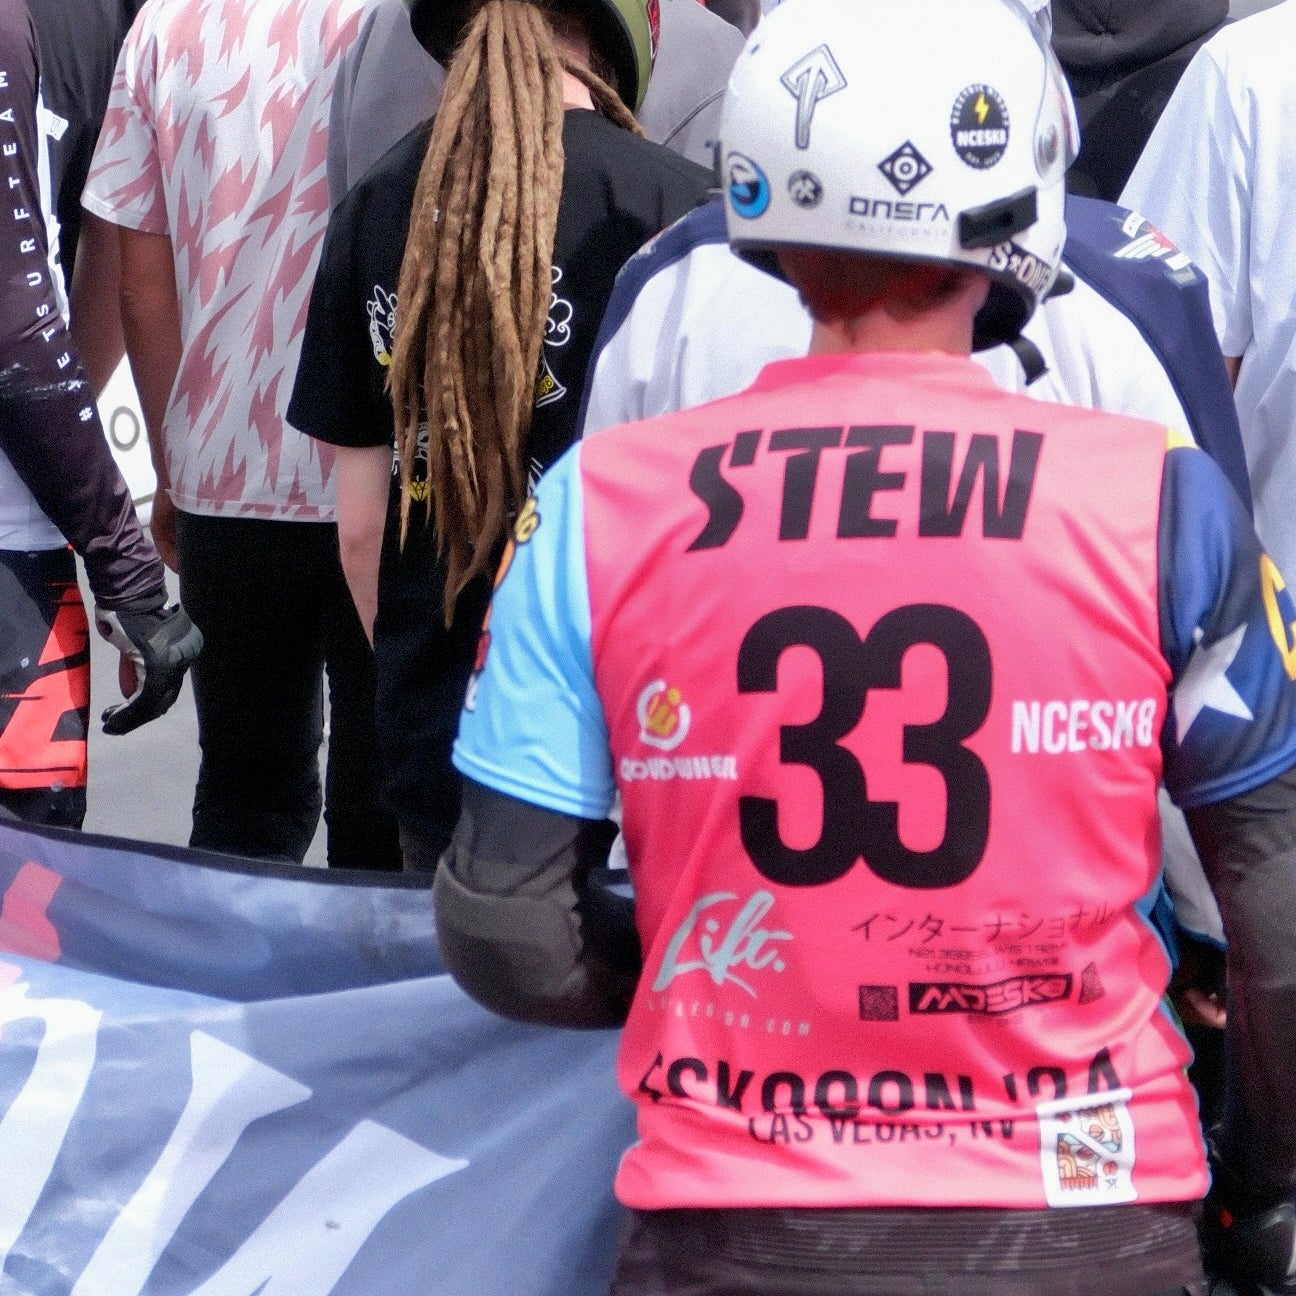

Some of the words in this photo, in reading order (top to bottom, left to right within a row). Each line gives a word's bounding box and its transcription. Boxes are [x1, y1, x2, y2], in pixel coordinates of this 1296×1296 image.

[686, 424, 1045, 554] STEW
[737, 602, 994, 892] 33
[1010, 697, 1157, 754] NCESK8
